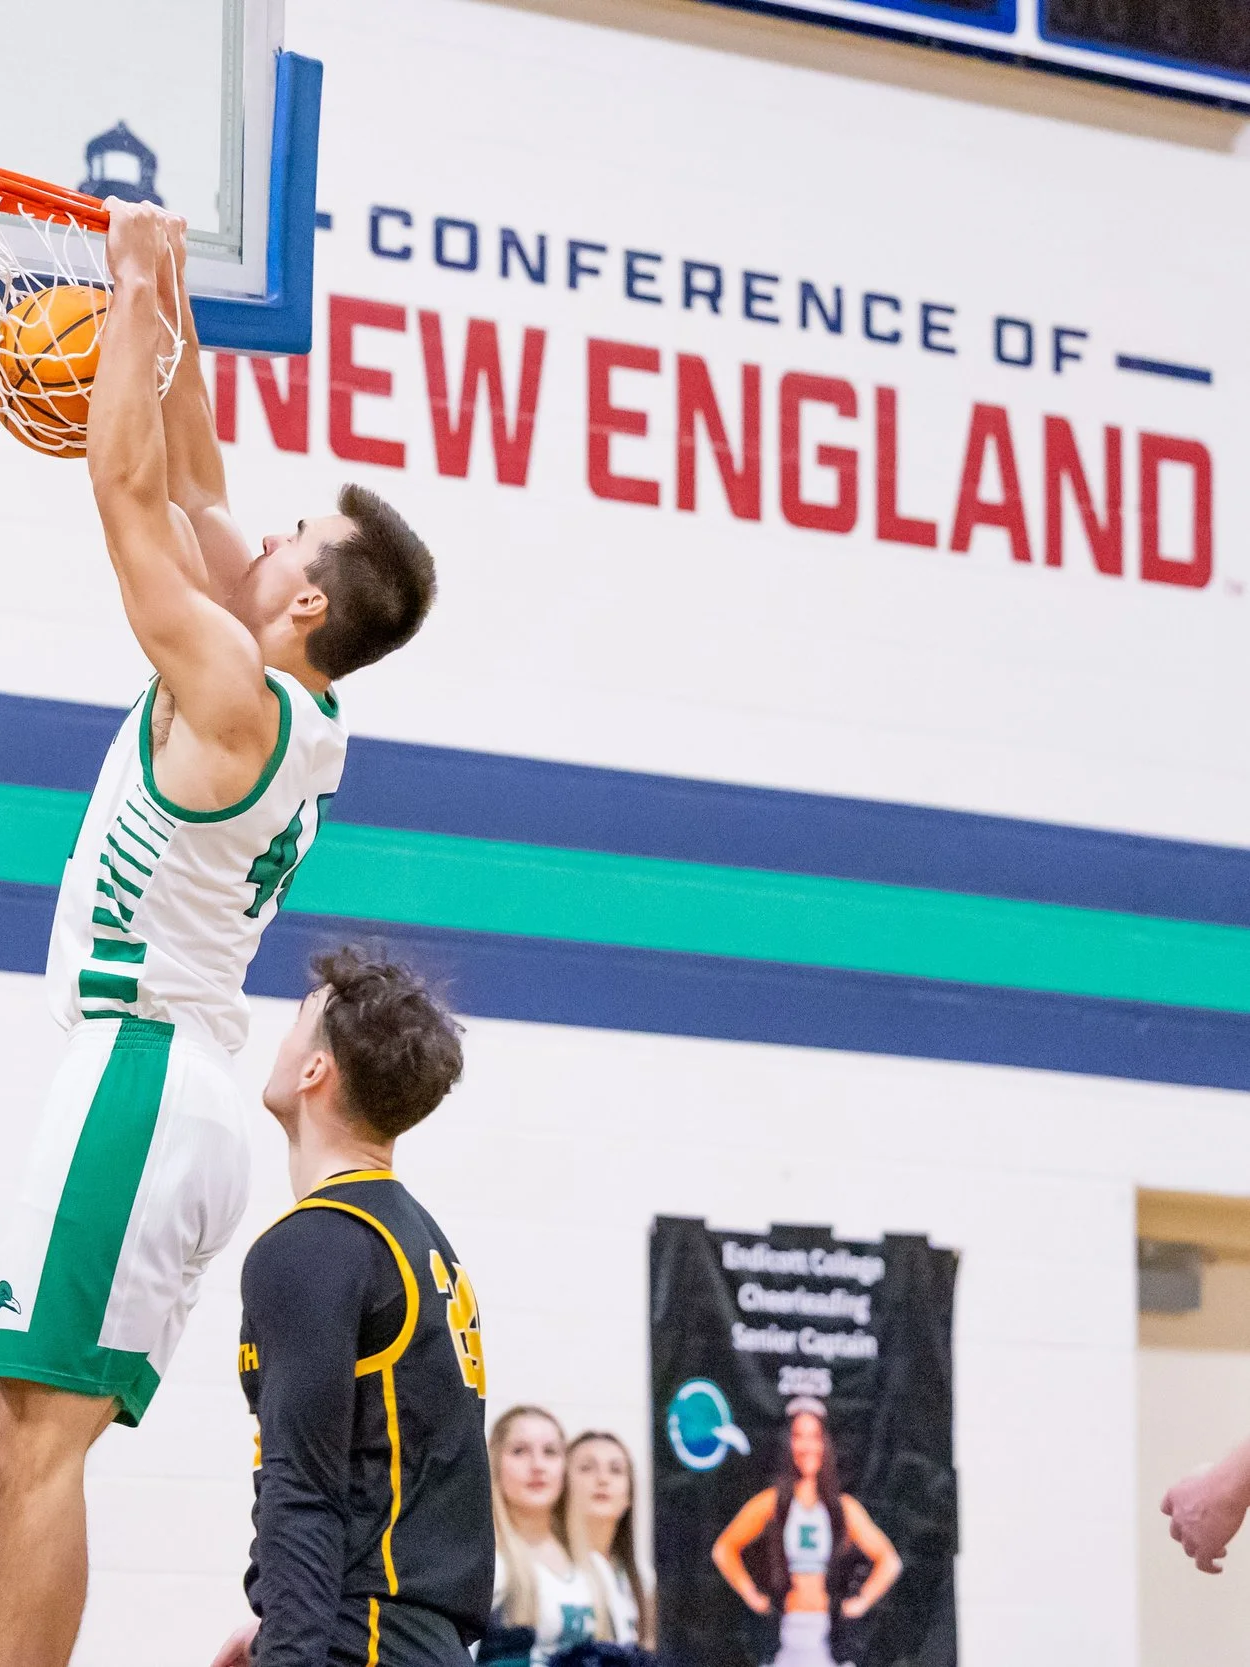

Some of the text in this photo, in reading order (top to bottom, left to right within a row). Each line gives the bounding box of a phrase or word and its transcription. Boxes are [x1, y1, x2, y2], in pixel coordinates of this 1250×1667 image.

[369, 206, 1089, 373] CONFERENCE OF
[214, 294, 1214, 591] NEW ENGLAND
[808, 1248, 886, 1287] College
[737, 1282, 872, 1326] Cheerleading
[731, 1322, 879, 1361] Senior Captain
